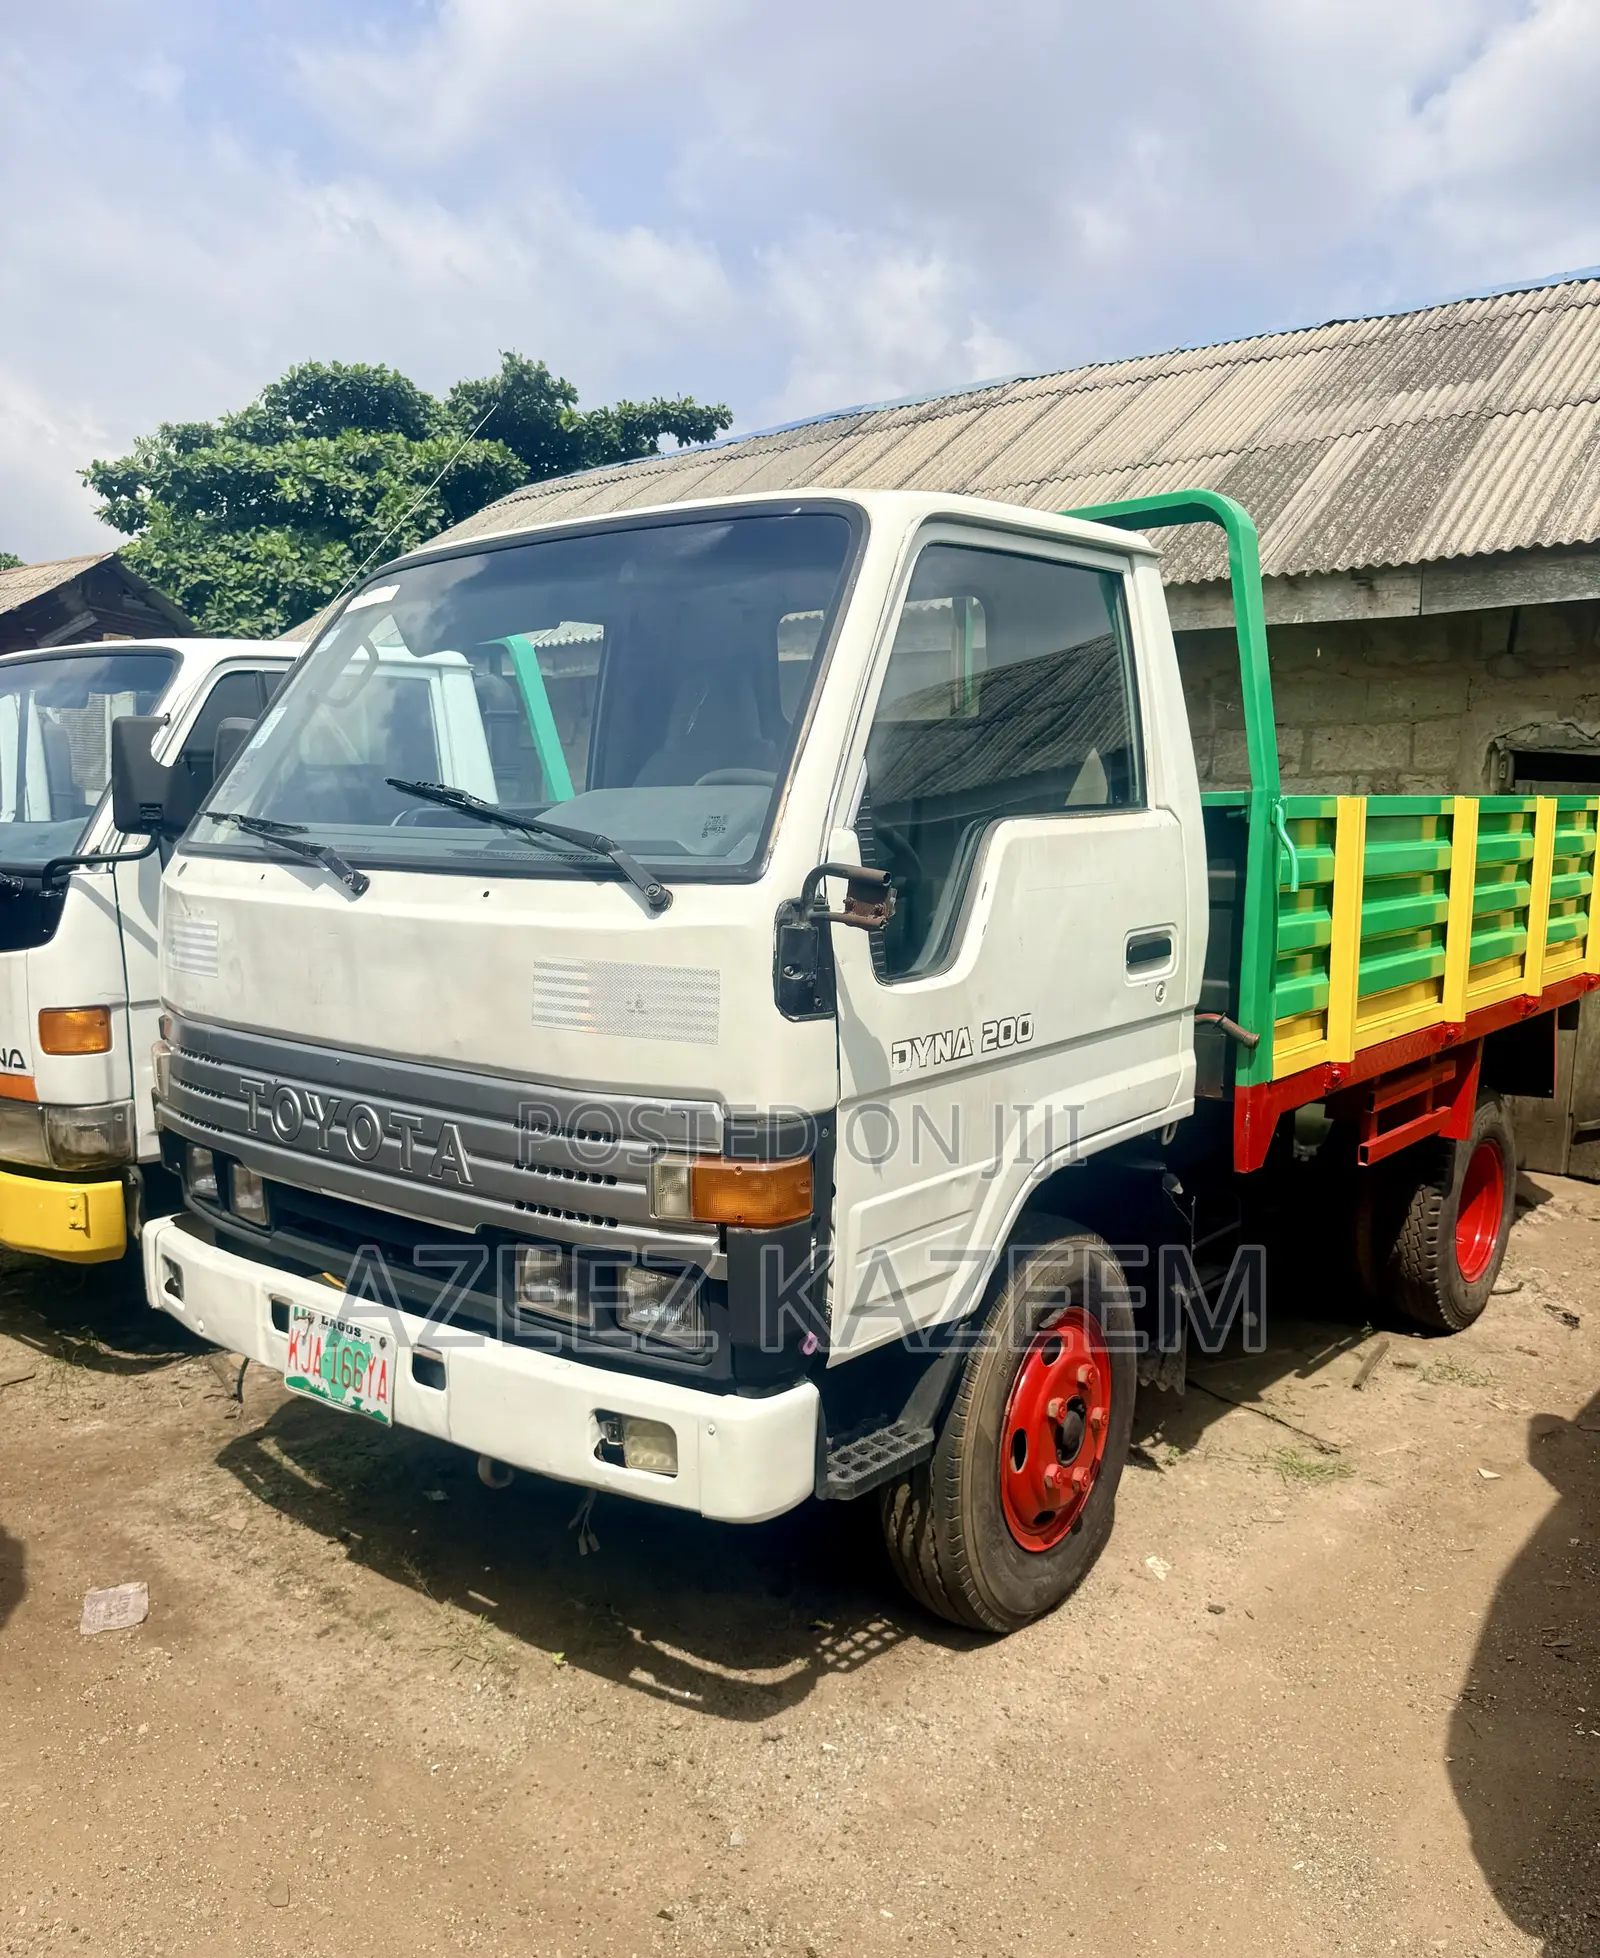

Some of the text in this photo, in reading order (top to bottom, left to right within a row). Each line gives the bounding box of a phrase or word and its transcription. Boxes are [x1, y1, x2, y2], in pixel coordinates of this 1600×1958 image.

[892, 1013, 1035, 1074] DYNA 200
[239, 1076, 475, 1187] TOYOTA
[320, 1315, 362, 1338] LAGOS
